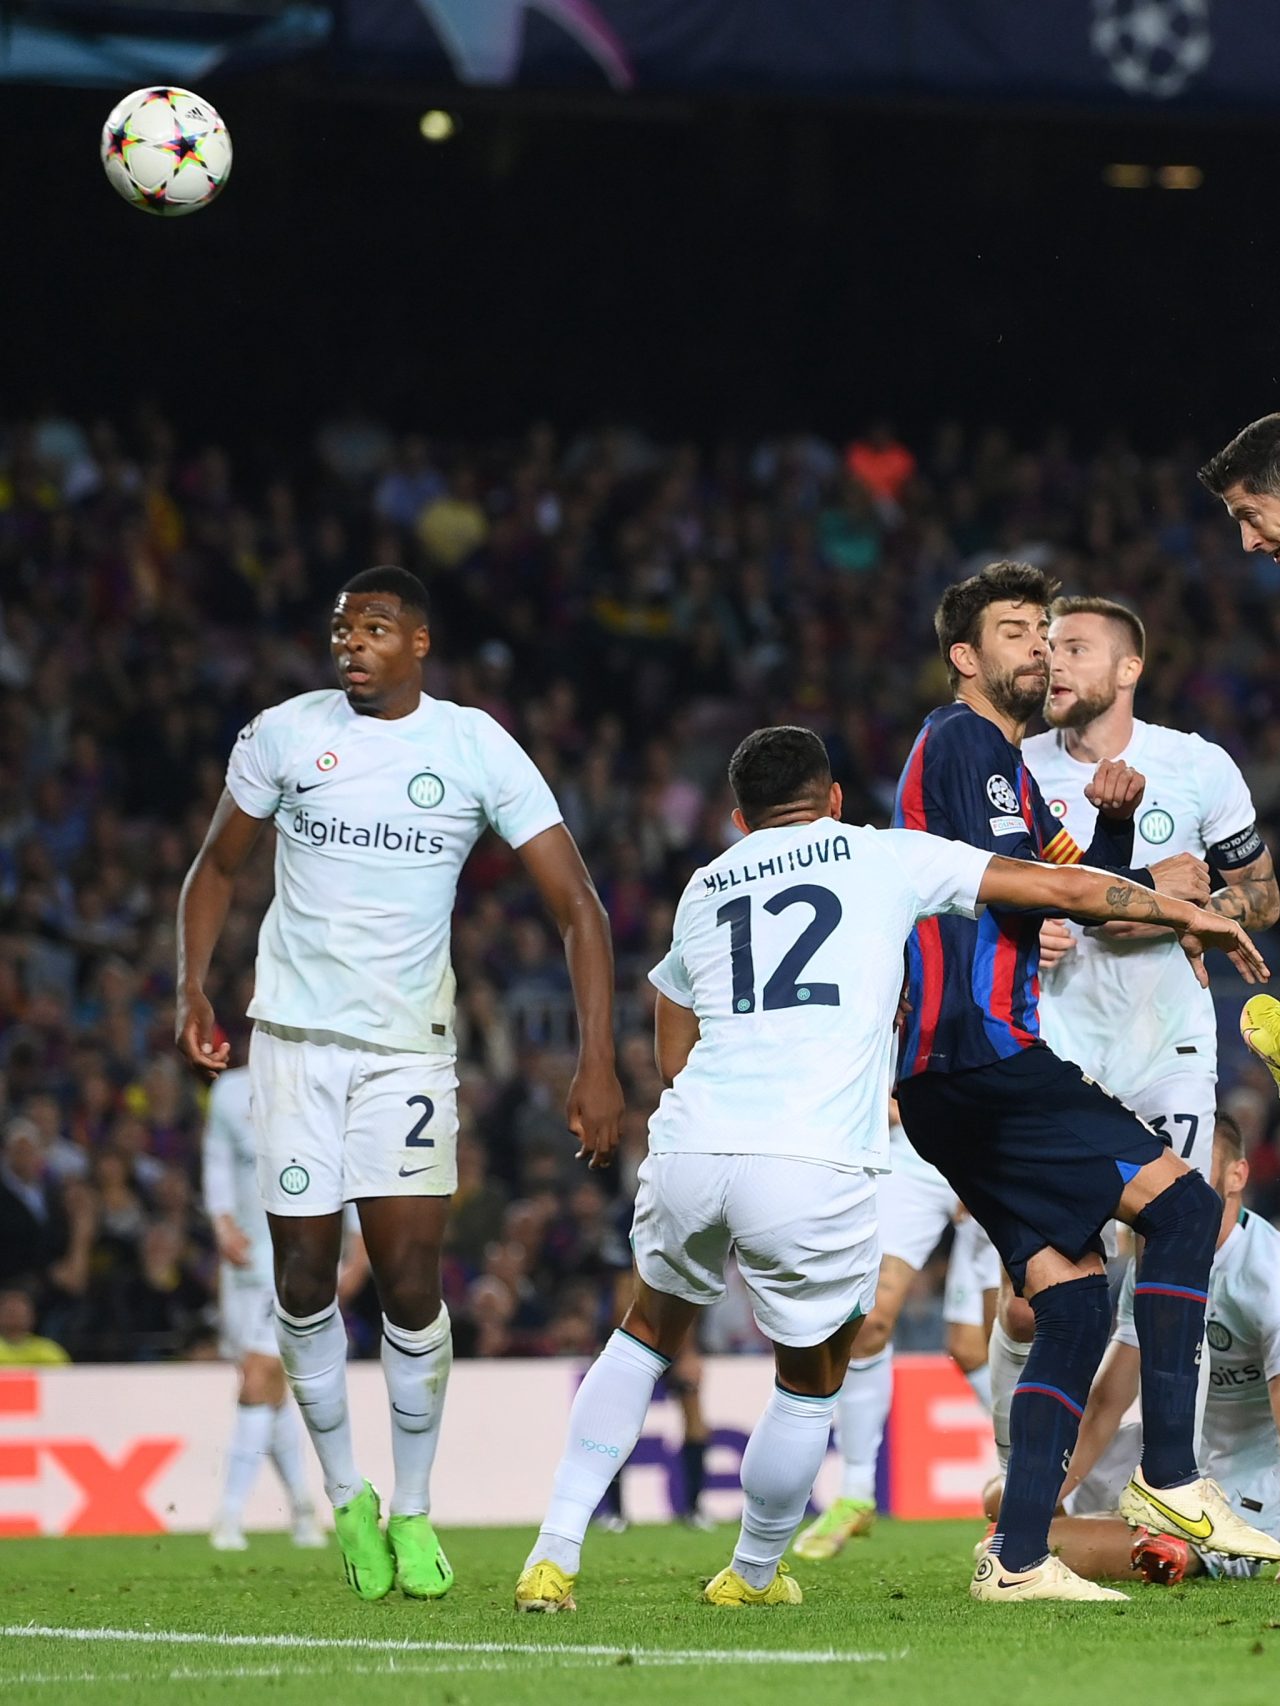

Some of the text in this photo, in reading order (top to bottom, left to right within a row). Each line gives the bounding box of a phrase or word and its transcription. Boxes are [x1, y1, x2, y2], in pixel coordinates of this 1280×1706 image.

[293, 810, 445, 854] digitalbits
[716, 884, 843, 1014] 12
[405, 1094, 435, 1148] 2
[579, 1438, 620, 1459] 1908
